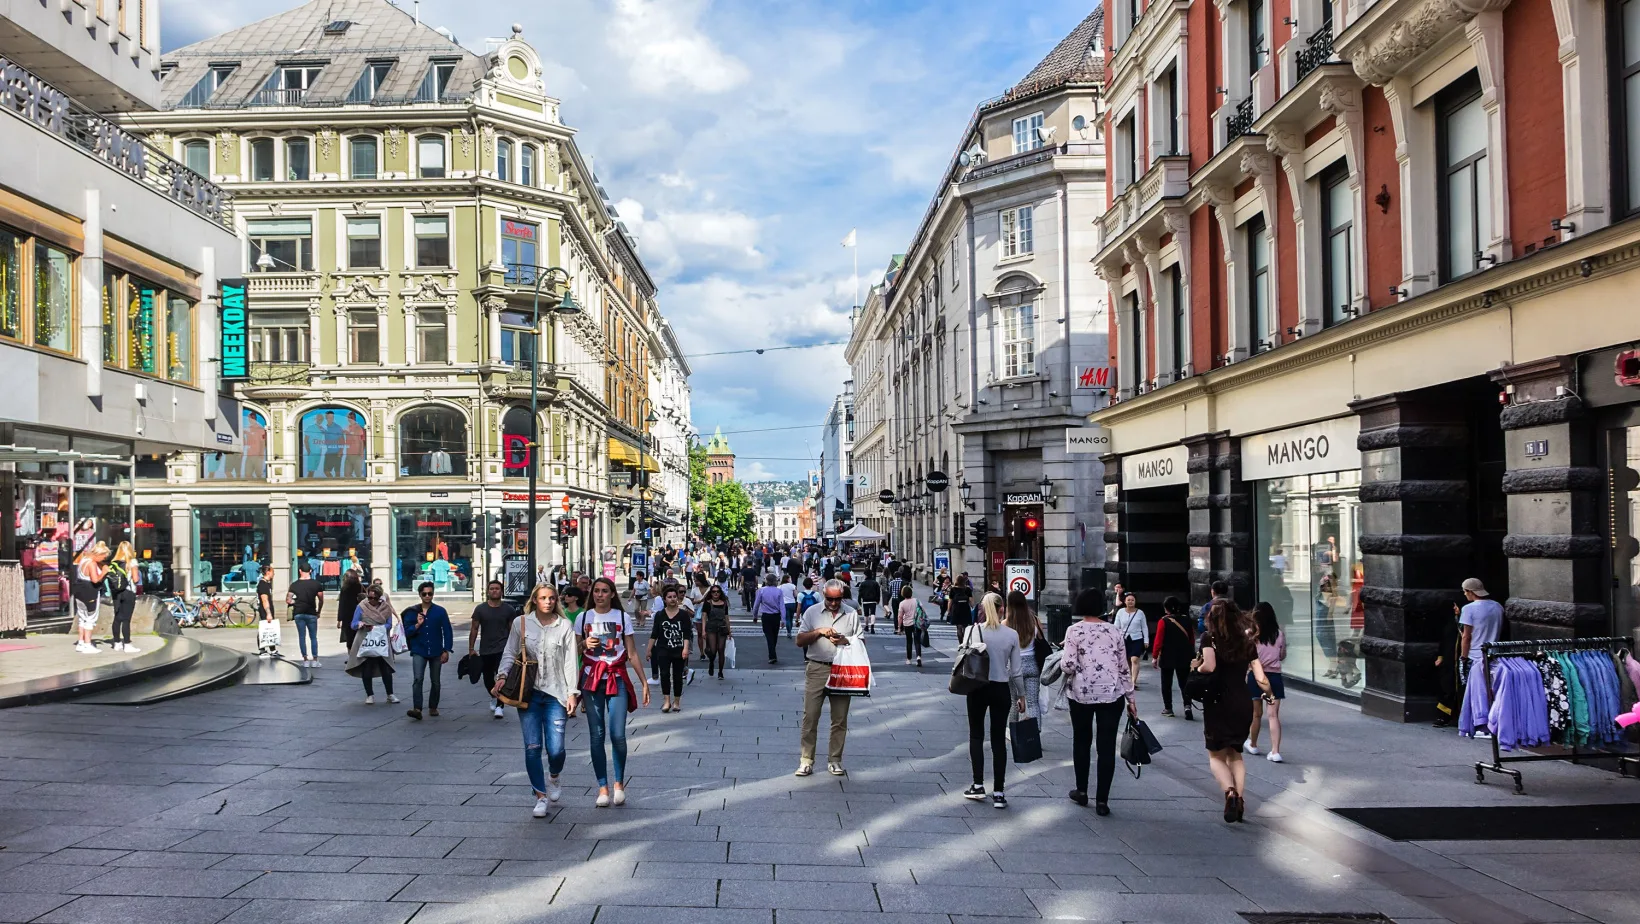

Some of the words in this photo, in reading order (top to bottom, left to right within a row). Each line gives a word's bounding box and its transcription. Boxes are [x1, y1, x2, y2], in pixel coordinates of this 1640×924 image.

[1080, 367, 1109, 387] H&M
[502, 433, 530, 469] D
[1267, 434, 1330, 466] MANGO
[1138, 457, 1173, 479] MANGO
[859, 475, 868, 486] 2
[1007, 493, 1041, 503] KappAhl
[1014, 582, 1028, 592] 30
